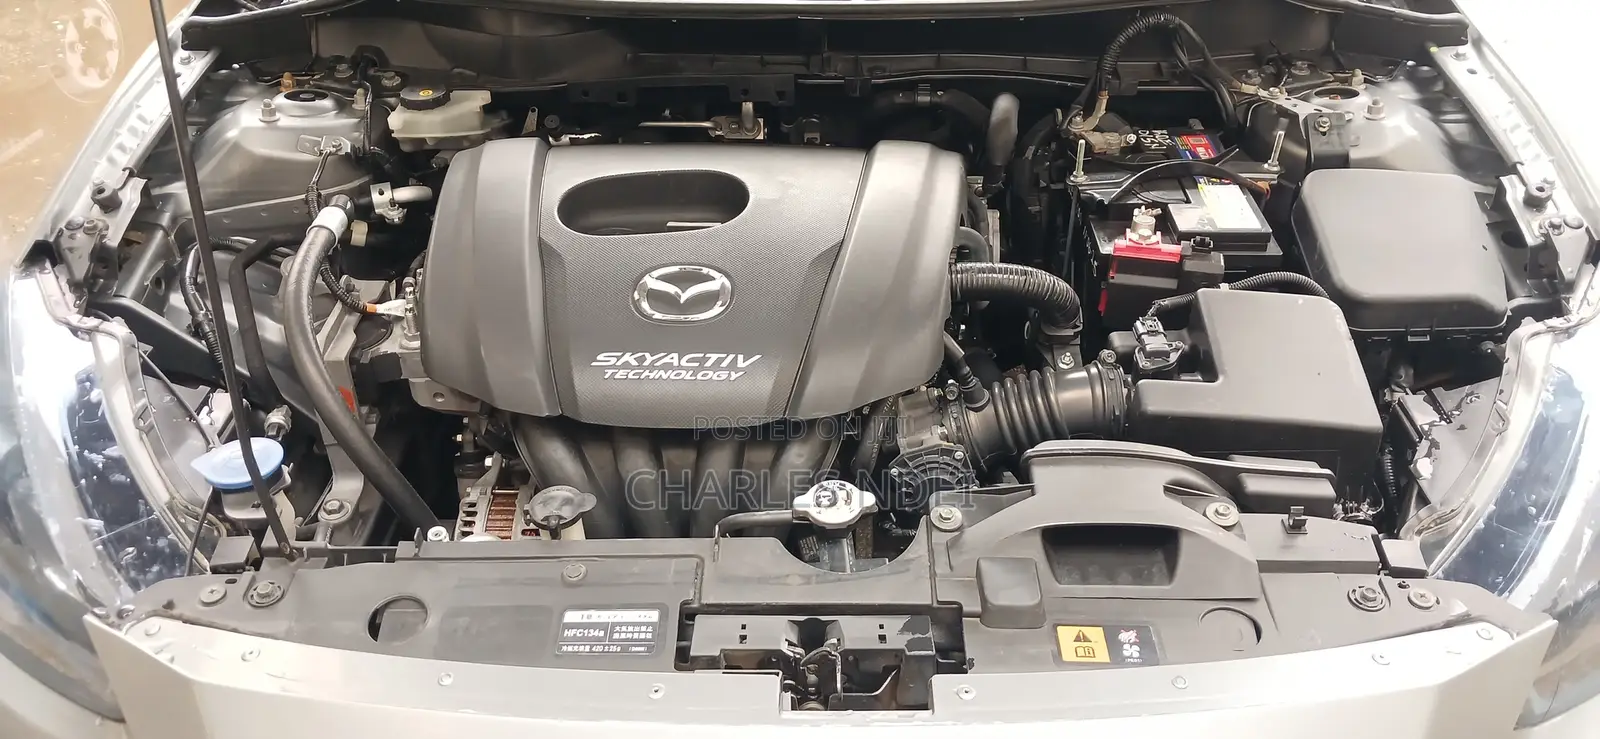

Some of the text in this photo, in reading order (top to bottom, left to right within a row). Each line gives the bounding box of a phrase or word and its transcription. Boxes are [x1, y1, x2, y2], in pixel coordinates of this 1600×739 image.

[591, 352, 762, 369] SKYACTIV
[603, 368, 746, 381] TECHNOLOGY
[563, 628, 605, 638] HFC134a
